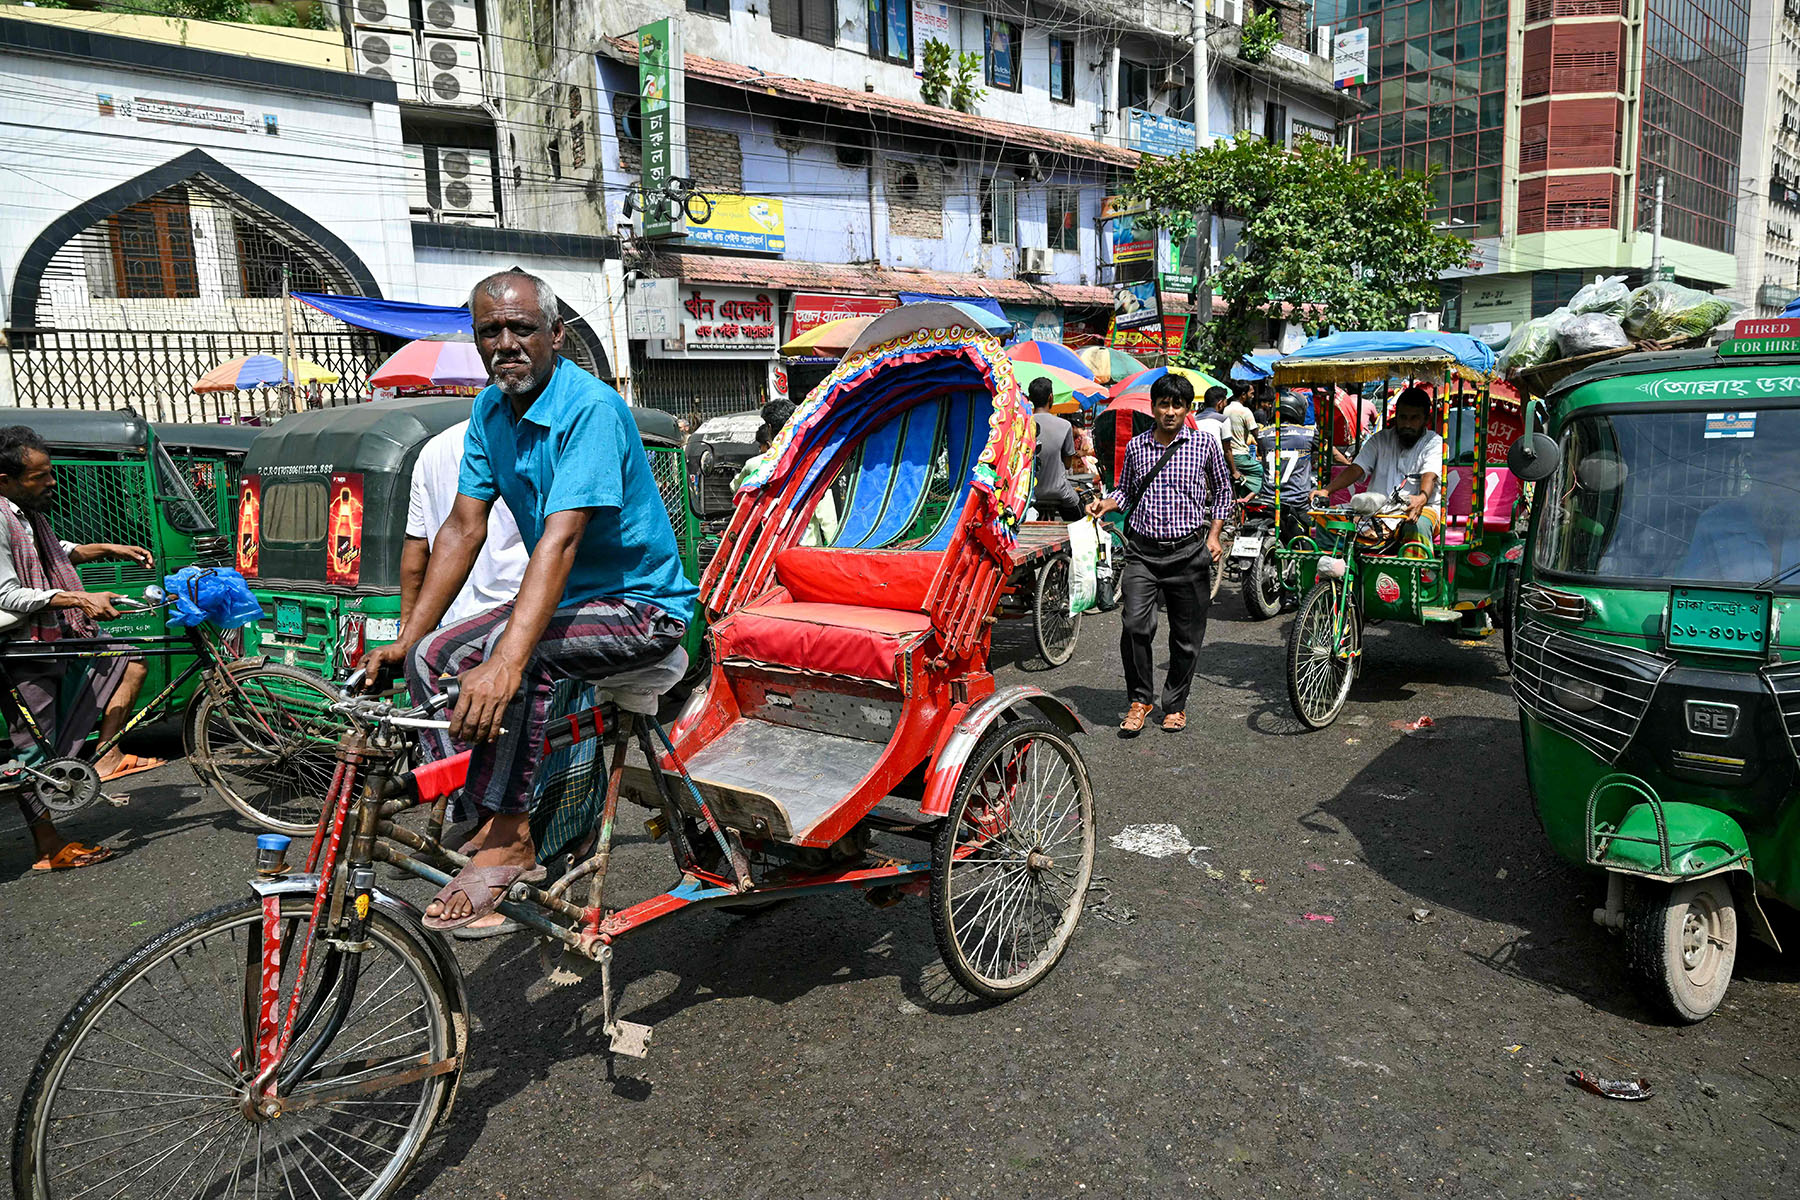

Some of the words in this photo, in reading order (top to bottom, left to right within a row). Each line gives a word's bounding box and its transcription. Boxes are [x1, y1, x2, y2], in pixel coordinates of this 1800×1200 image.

[1744, 323, 1790, 335] HIRED
[1734, 341, 1761, 353] FOR
[1765, 340, 1800, 352] HIRE
[1266, 450, 1299, 484] 17
[1677, 599, 1704, 610] ঢাকা
[1694, 712, 1728, 730] RE
